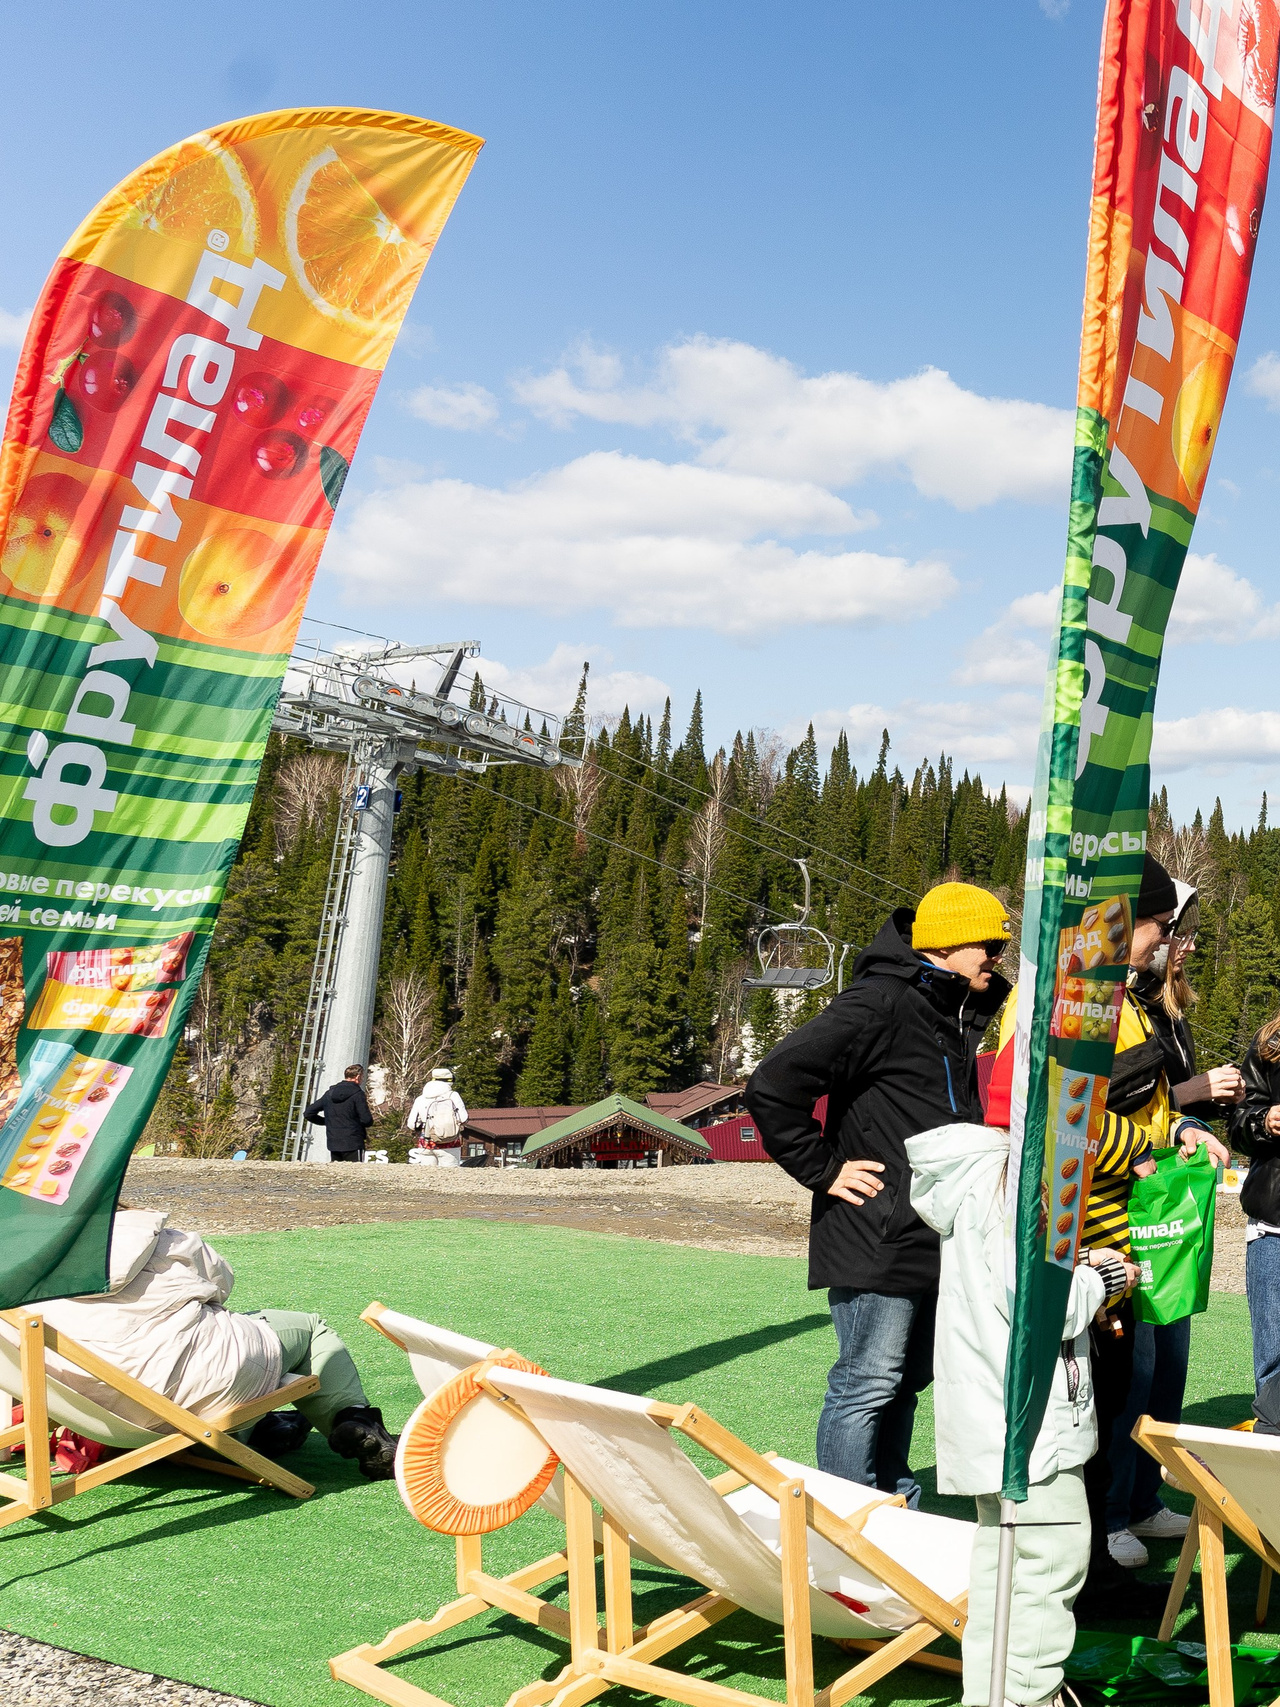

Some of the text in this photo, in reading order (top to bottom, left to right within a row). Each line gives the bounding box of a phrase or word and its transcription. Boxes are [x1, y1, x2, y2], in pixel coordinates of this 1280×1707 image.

[356, 788, 367, 807] 2
[55, 879, 211, 911] перекусы
[30, 906, 118, 931] семьи
[1129, 1219, 1184, 1239] тилад
